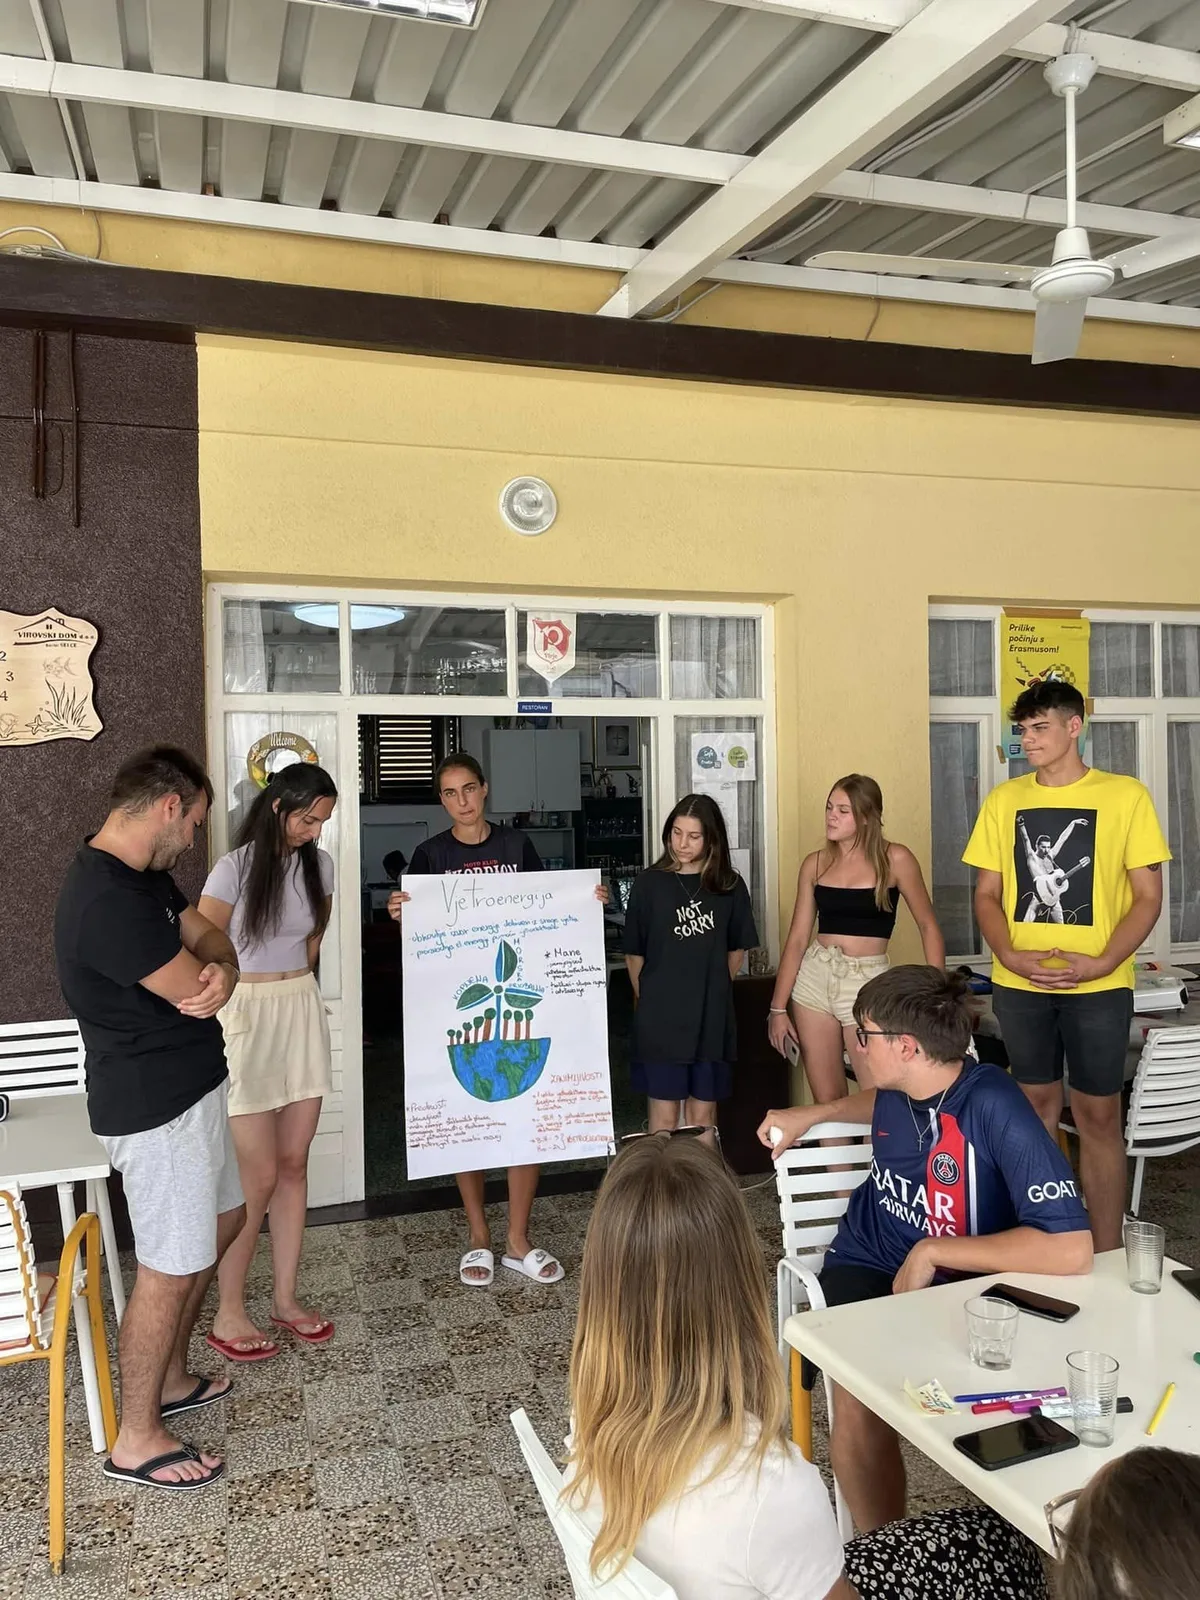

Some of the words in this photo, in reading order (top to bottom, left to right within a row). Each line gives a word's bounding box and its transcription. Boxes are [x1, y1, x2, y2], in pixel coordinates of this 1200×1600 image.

[1009, 624, 1035, 632] Prilike
[1009, 634, 1038, 644] počinju
[1009, 645, 1059, 653] Erasmusom!
[6, 671, 14, 682] 3
[0, 690, 8, 701] 4
[441, 878, 554, 927] Vjetroenergija
[675, 900, 702, 923] NOT
[674, 910, 715, 940] SORRY
[554, 947, 581, 957] Mane
[1027, 1180, 1077, 1203] GOAT
[879, 1195, 957, 1237] AIRWAYS
